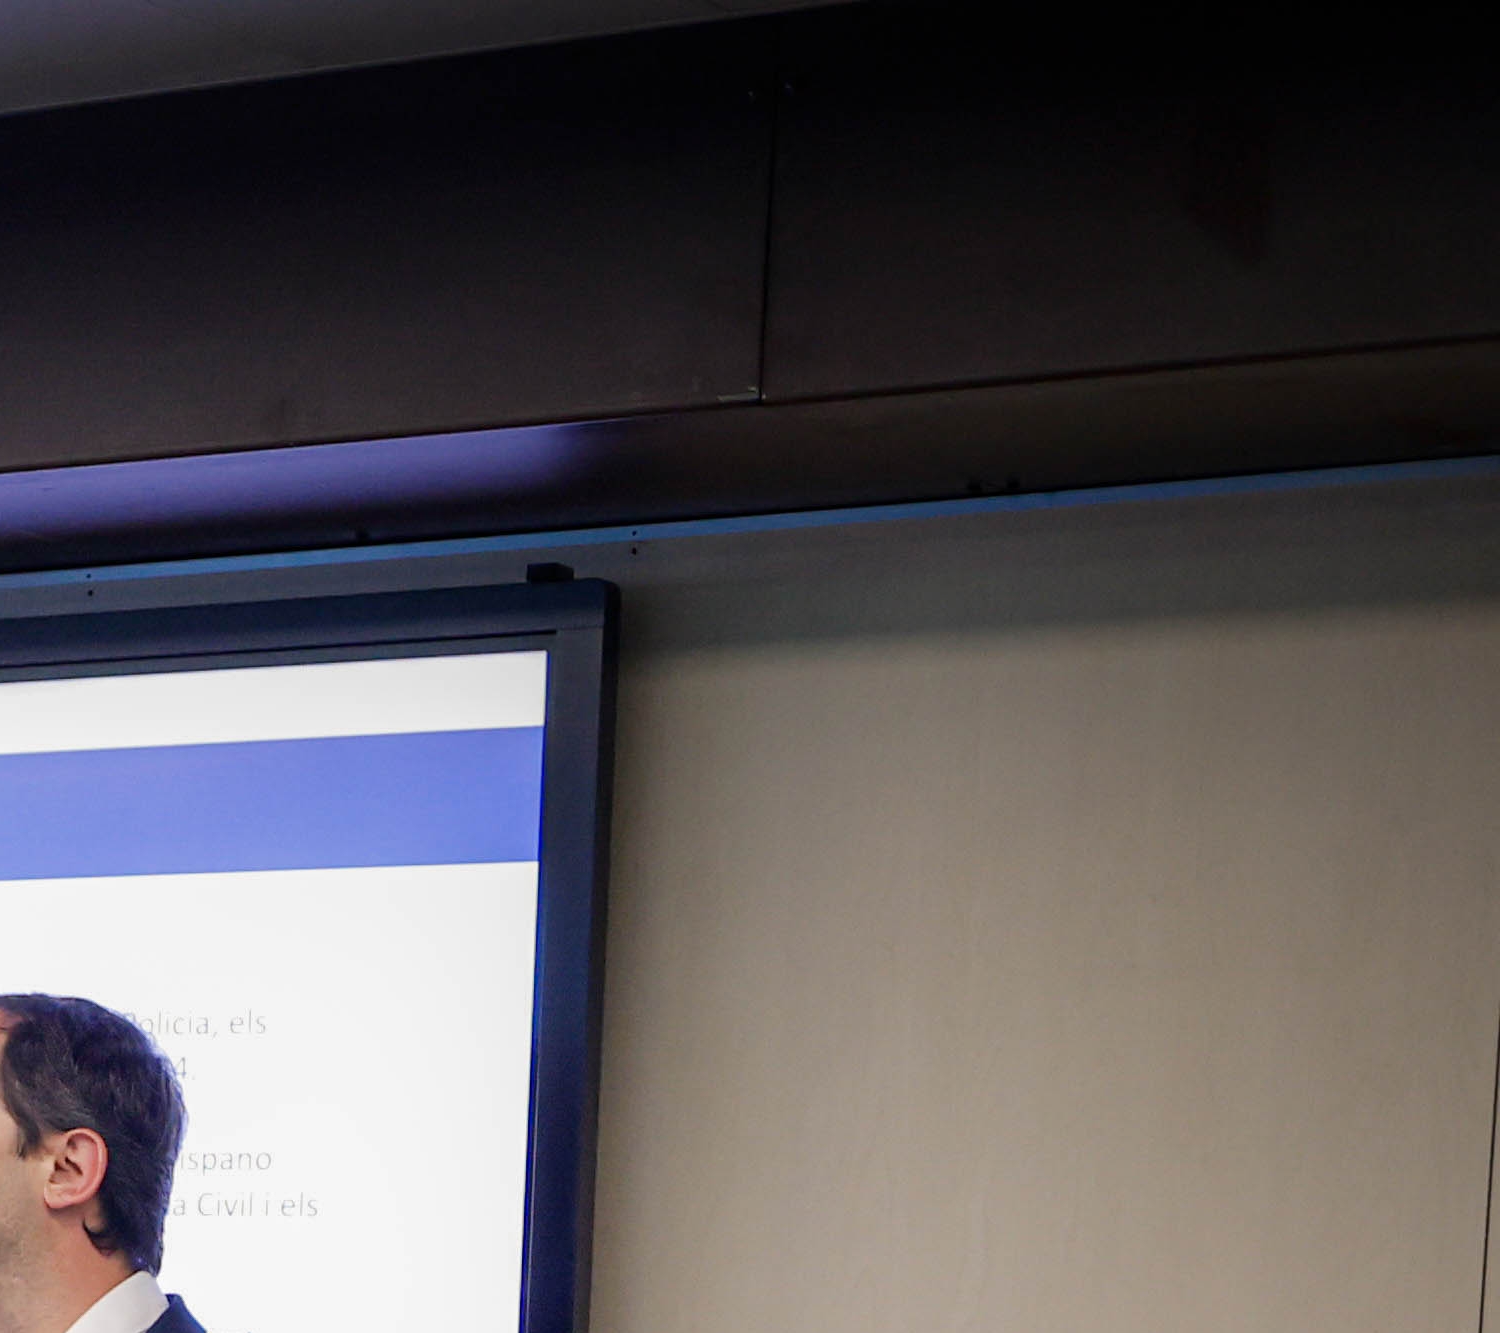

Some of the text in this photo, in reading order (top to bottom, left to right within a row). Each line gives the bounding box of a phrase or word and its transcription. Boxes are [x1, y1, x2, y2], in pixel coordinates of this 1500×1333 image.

[229, 1008, 267, 1035] els
[179, 1148, 273, 1176] ispano
[196, 1190, 254, 1217] Civil
[280, 1190, 319, 1217] els
